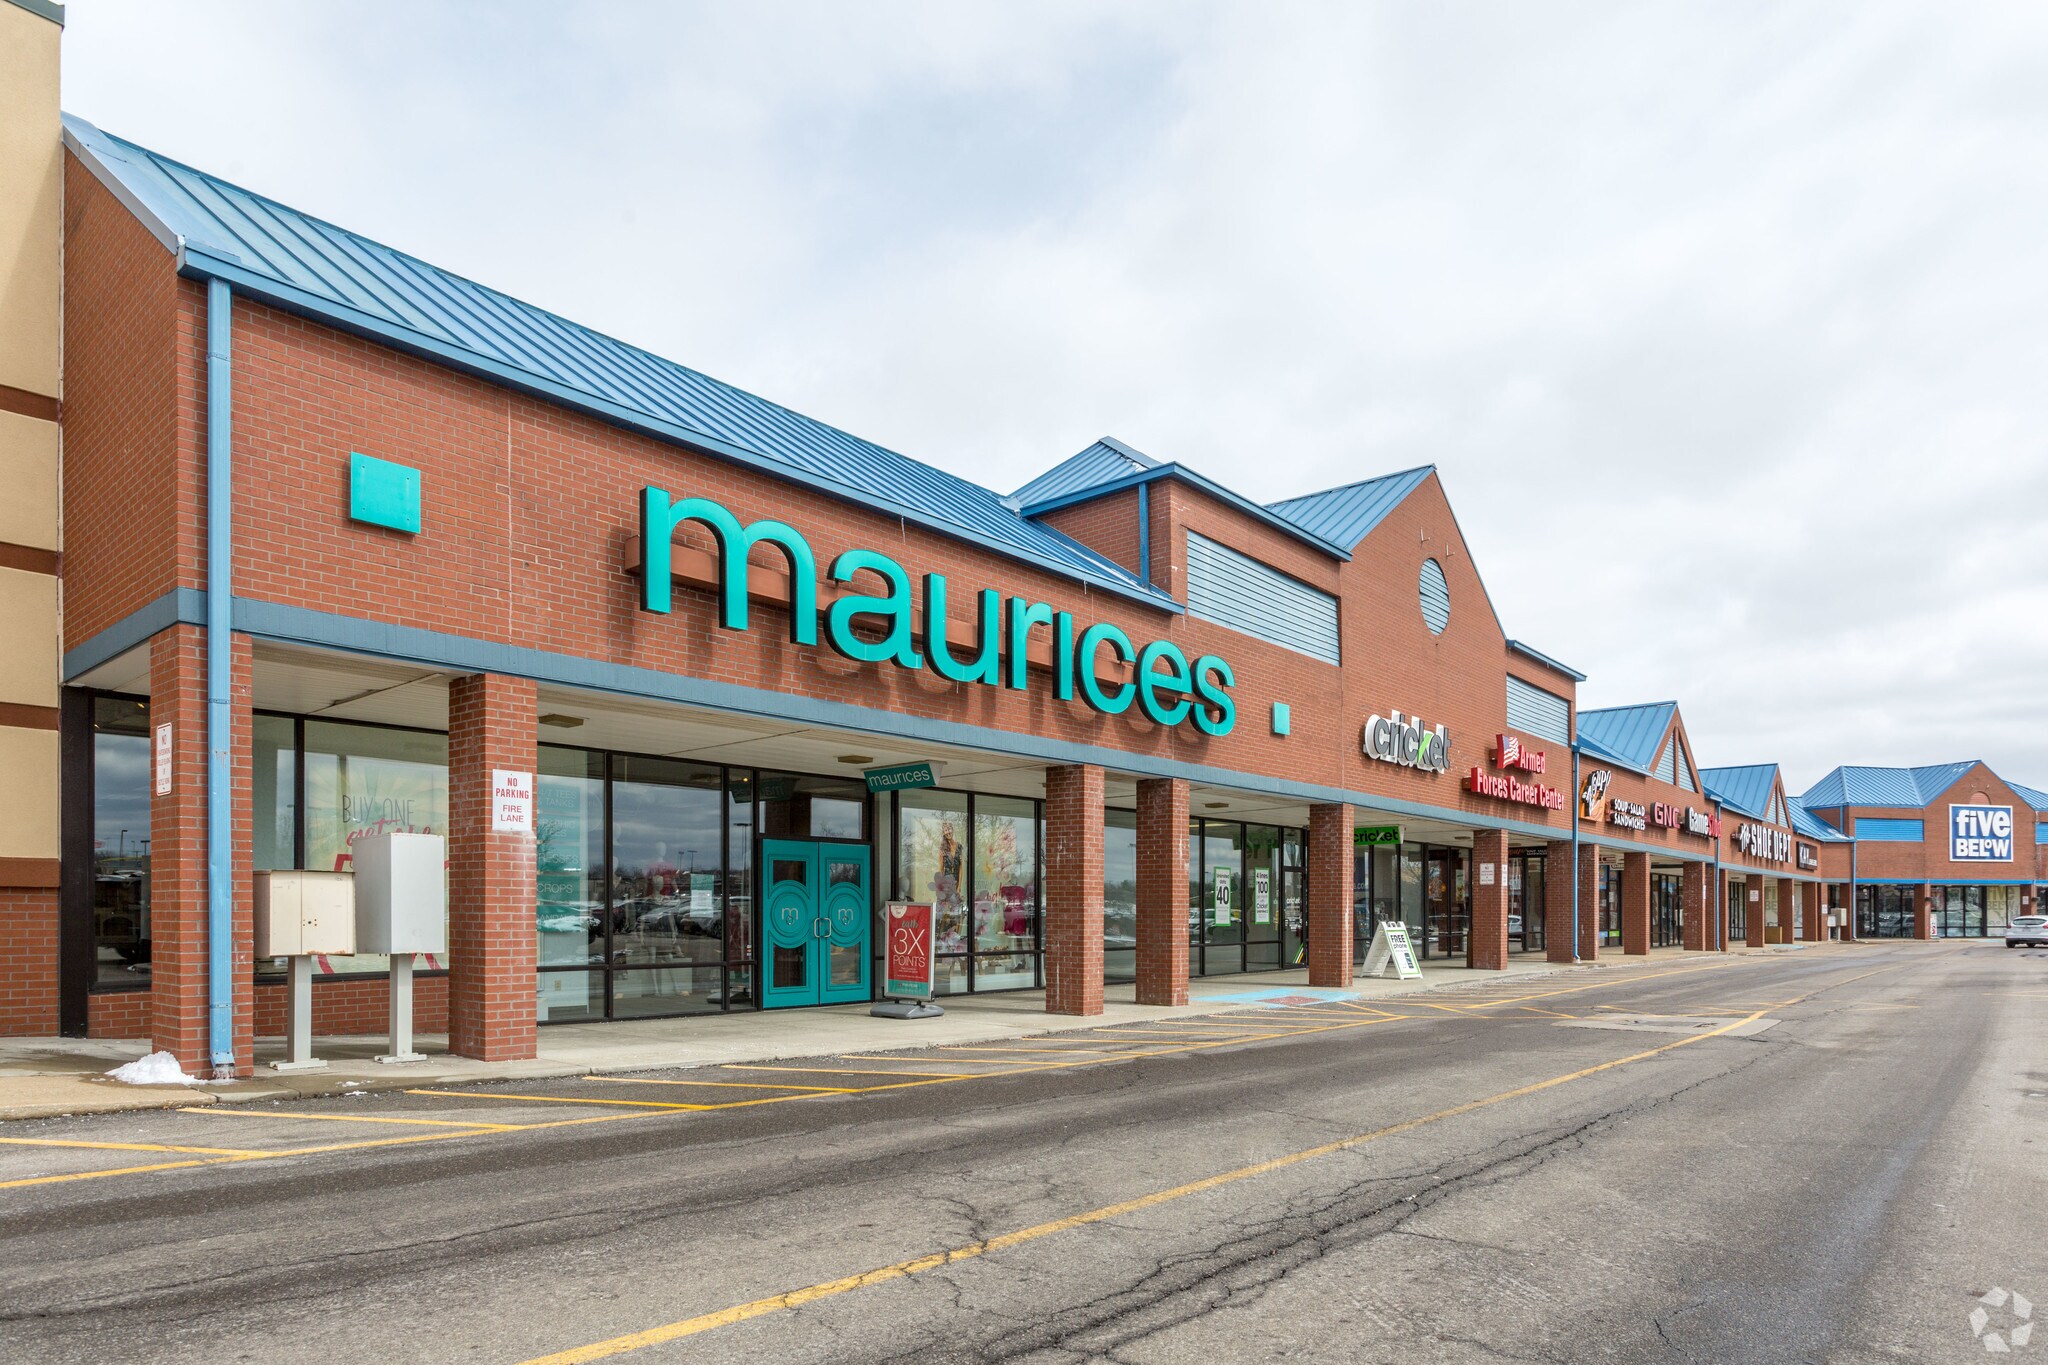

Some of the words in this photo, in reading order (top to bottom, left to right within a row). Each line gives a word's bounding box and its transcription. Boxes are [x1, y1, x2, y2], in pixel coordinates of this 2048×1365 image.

[640, 485, 1236, 737] maurices
[1372, 712, 1452, 770] cricket
[1519, 748, 1546, 774] Armed
[507, 777, 518, 787] NO
[868, 768, 930, 787] maurices
[495, 787, 530, 800] PARKING
[1476, 767, 1508, 797] Forces
[1509, 775, 1538, 804] Career
[1539, 783, 1565, 811] Center
[342, 794, 374, 824] BUY
[382, 797, 416, 827] ONE
[500, 813, 525, 823] LANE
[502, 804, 523, 813] FIRE
[1654, 801, 1681, 829] GNC
[1614, 812, 1646, 831] SANDWICHES
[1354, 828, 1399, 842] cricket
[1751, 823, 1772, 859] SHOE
[538, 852, 579, 864] RESSES
[537, 883, 573, 894] CROPS
[893, 928, 925, 956] 3X
[1390, 934, 1406, 943] FREE
[893, 955, 926, 968] POINTS
